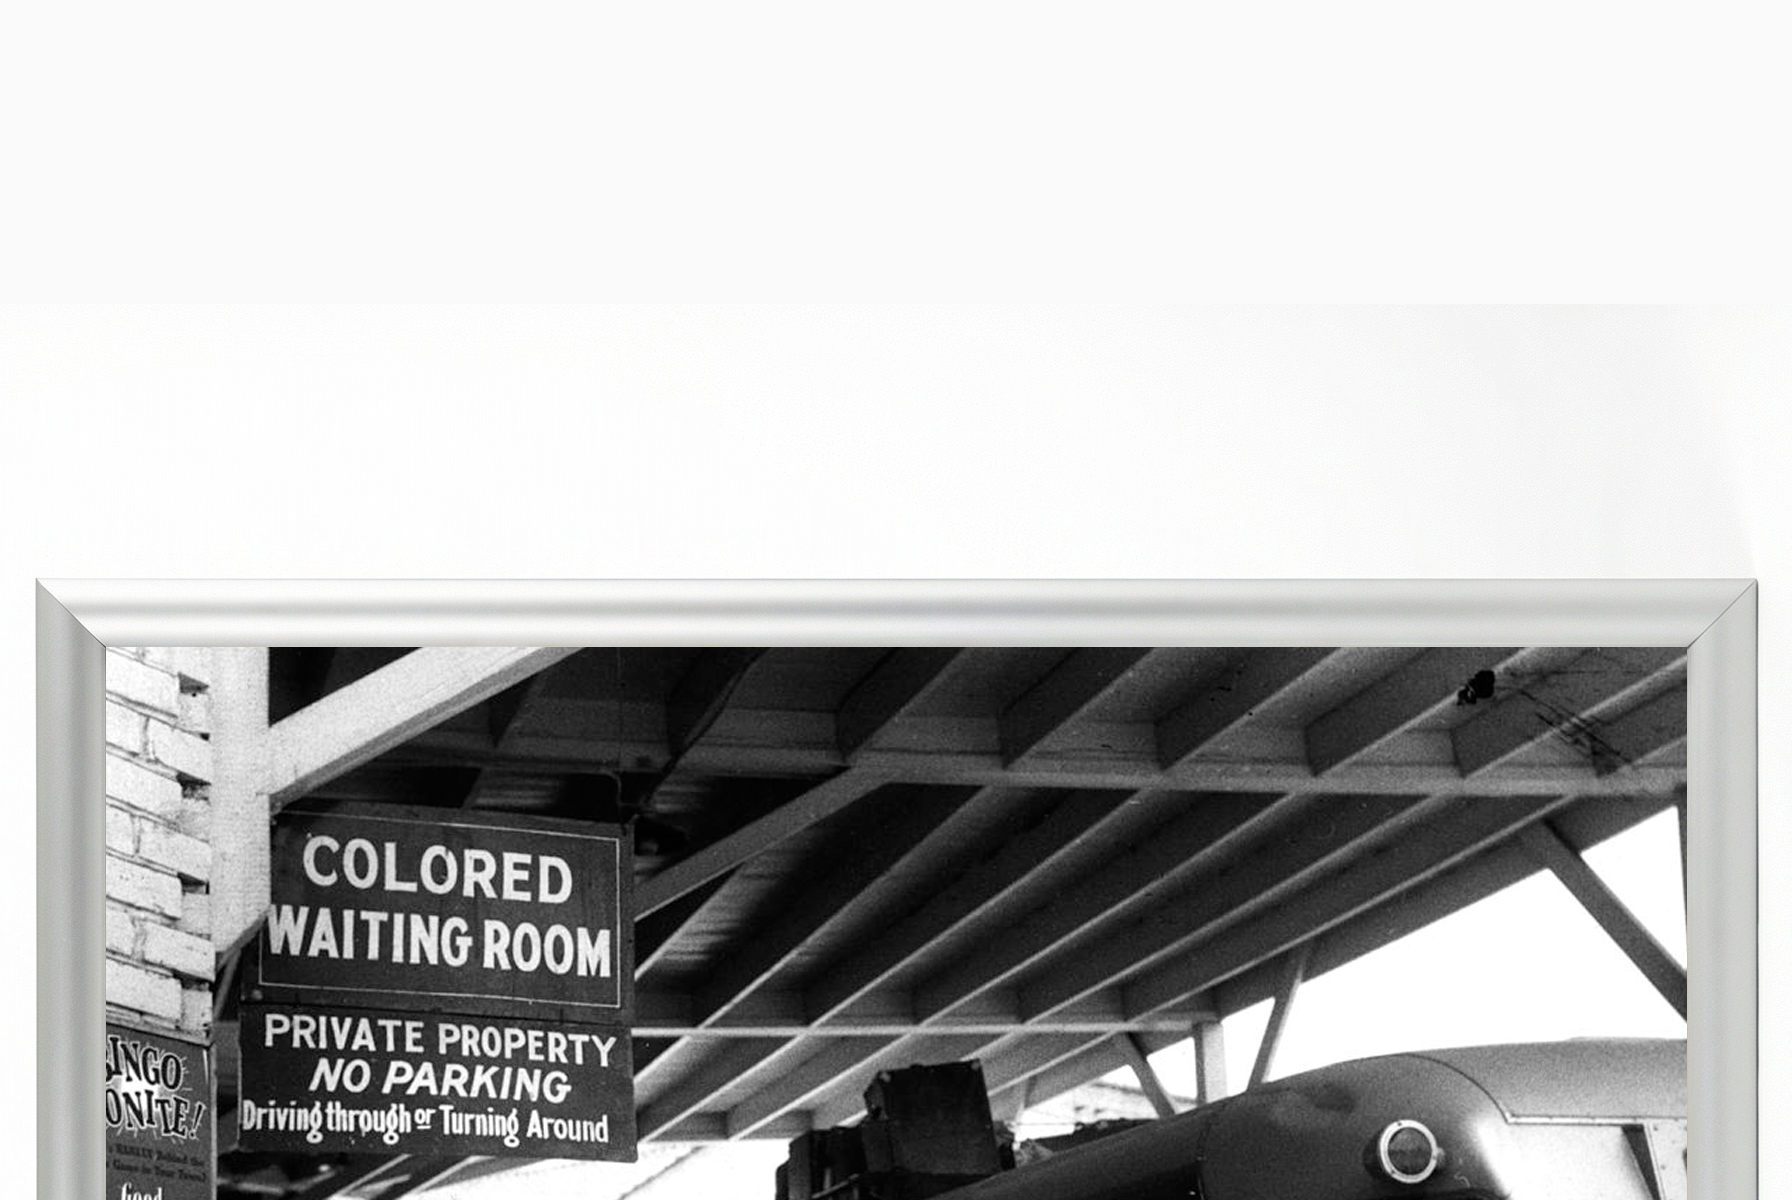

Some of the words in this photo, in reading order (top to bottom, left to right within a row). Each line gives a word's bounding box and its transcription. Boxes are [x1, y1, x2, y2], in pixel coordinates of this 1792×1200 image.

[302, 835, 573, 904] COLORED
[267, 903, 474, 968] WAITING
[483, 918, 612, 978] ROOM
[264, 1013, 425, 1053] PRIVATE
[438, 1022, 617, 1068] PROPERTY
[308, 1057, 372, 1093] NO
[382, 1060, 573, 1105] PARKING
[241, 1099, 324, 1145] Driving
[326, 1101, 412, 1146] through
[414, 1108, 436, 1129] or
[439, 1104, 519, 1149] Turning
[526, 1114, 610, 1145] Around
